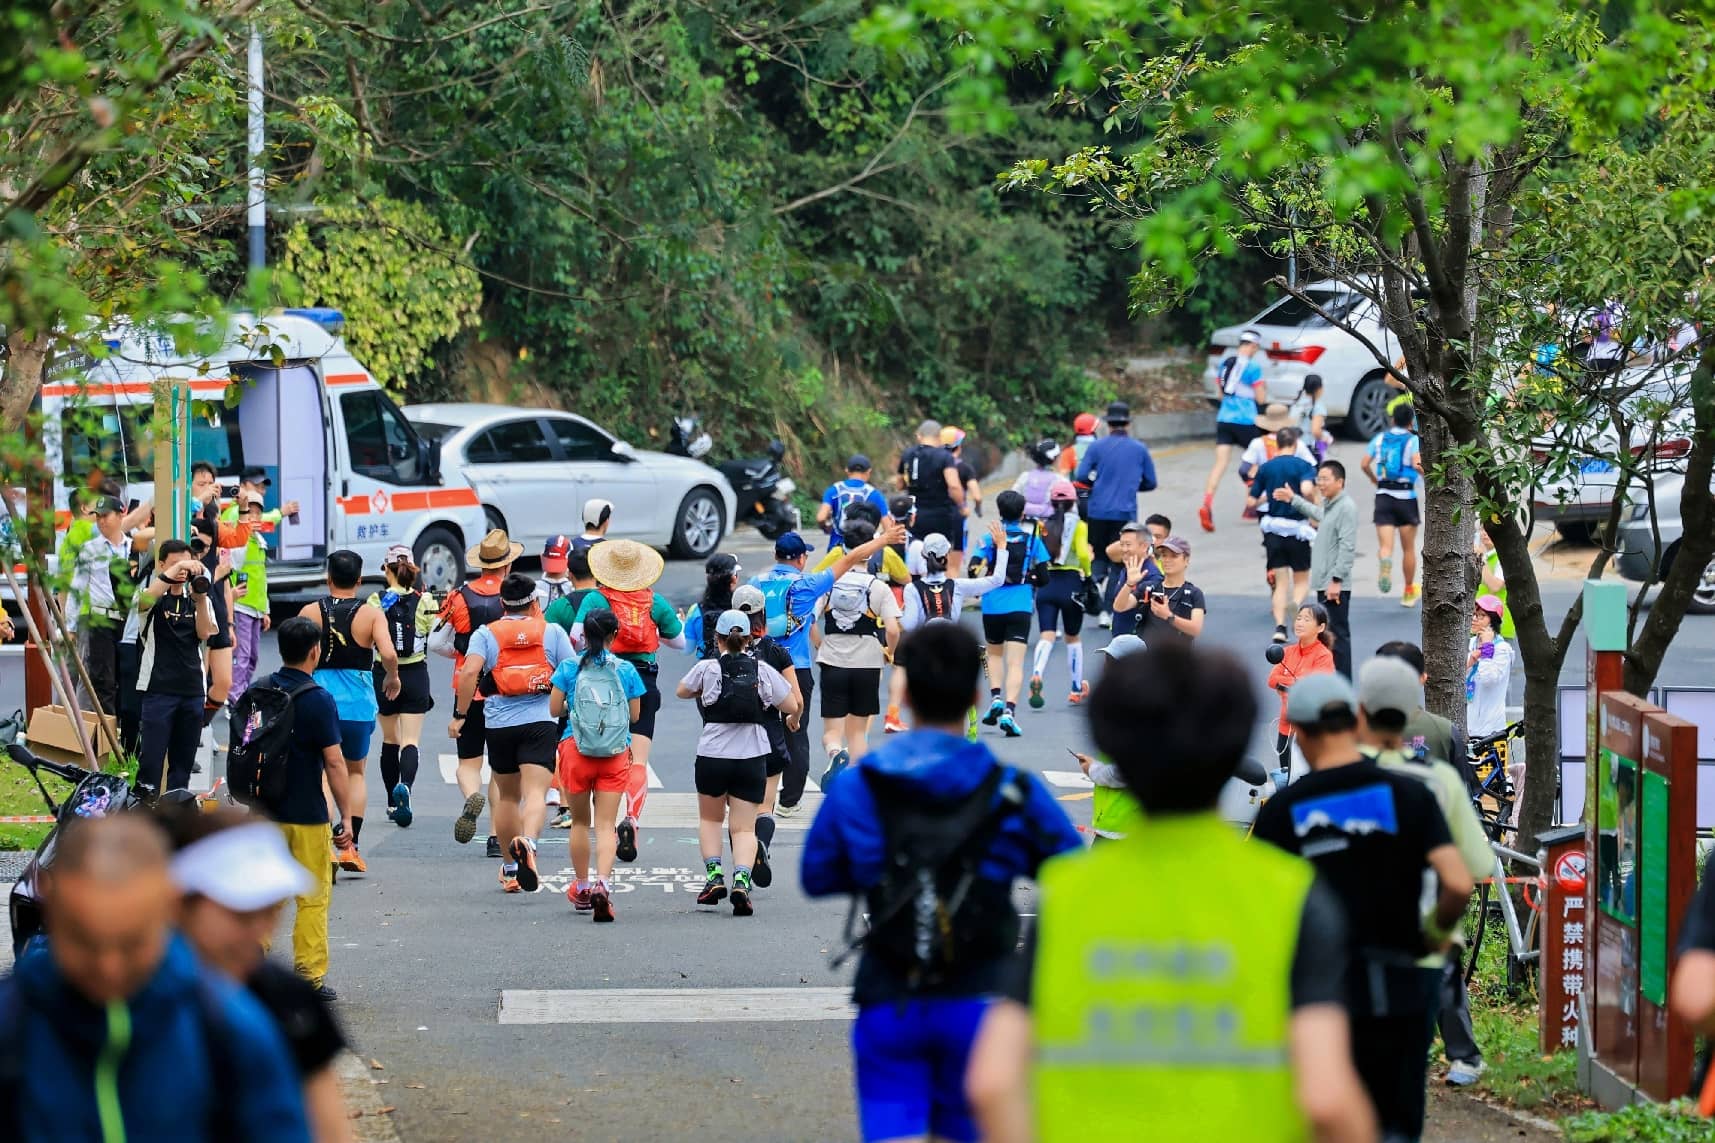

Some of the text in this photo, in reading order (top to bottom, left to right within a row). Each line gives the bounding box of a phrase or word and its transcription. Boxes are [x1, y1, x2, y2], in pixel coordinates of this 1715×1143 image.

[1561, 896, 1585, 1048] 严禁携带火种
